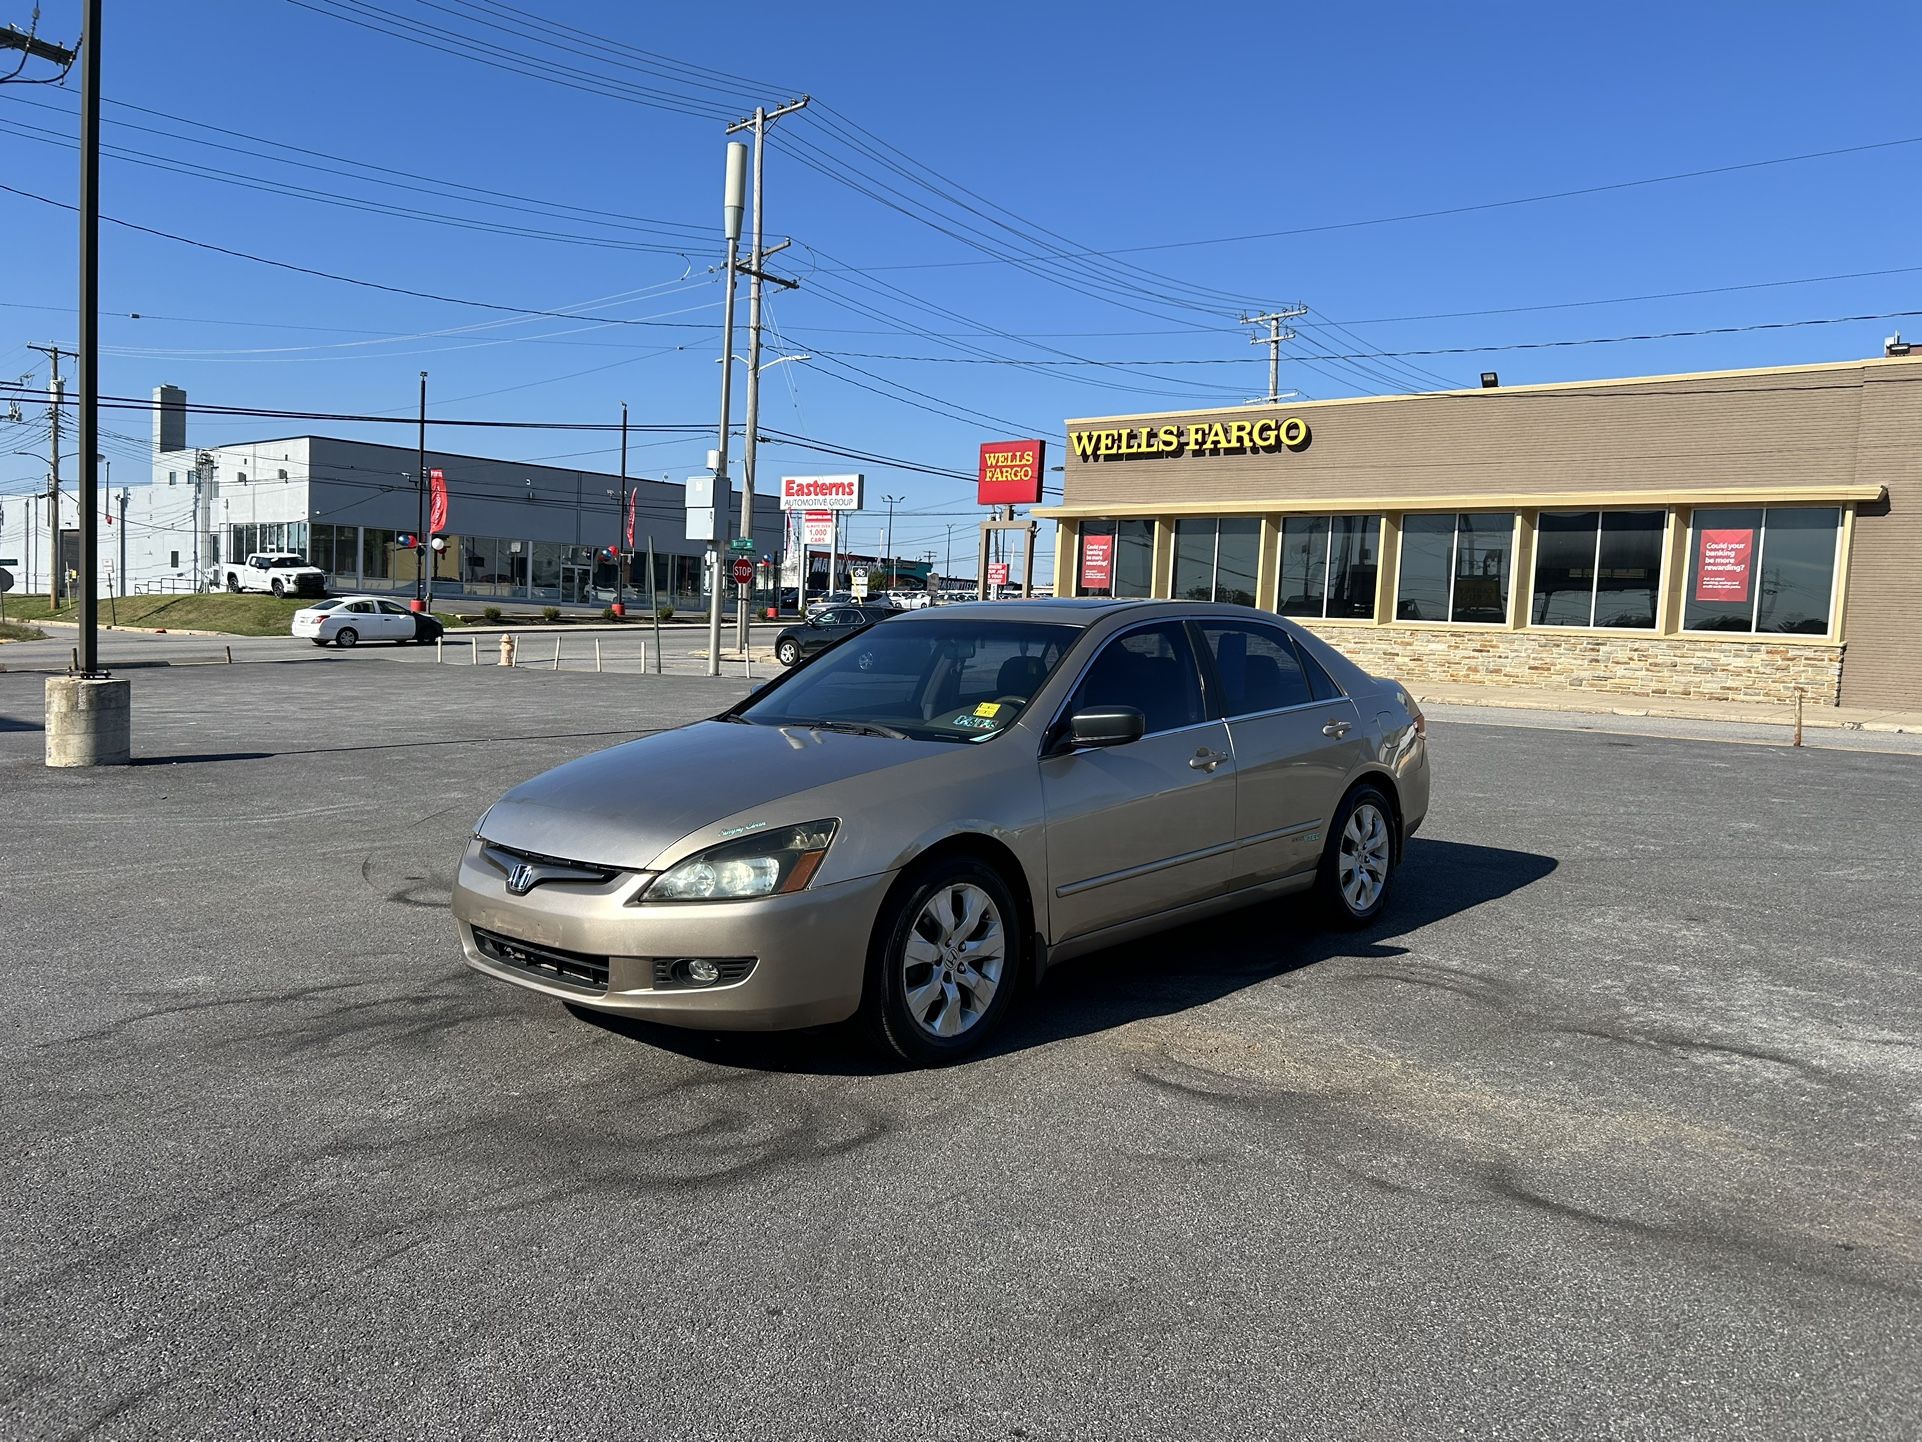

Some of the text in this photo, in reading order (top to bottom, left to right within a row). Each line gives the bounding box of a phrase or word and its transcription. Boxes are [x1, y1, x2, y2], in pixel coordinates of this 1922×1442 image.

[1069, 417, 1308, 457] WELLS FARGO
[985, 451, 1033, 467] WELLS
[985, 466, 1032, 482] FARGO
[785, 479, 854, 497] Easterns
[784, 498, 854, 507] AUTOMOTIVE GROUP
[734, 566, 752, 577] STOP
[1704, 564, 1745, 572] rewarding?
